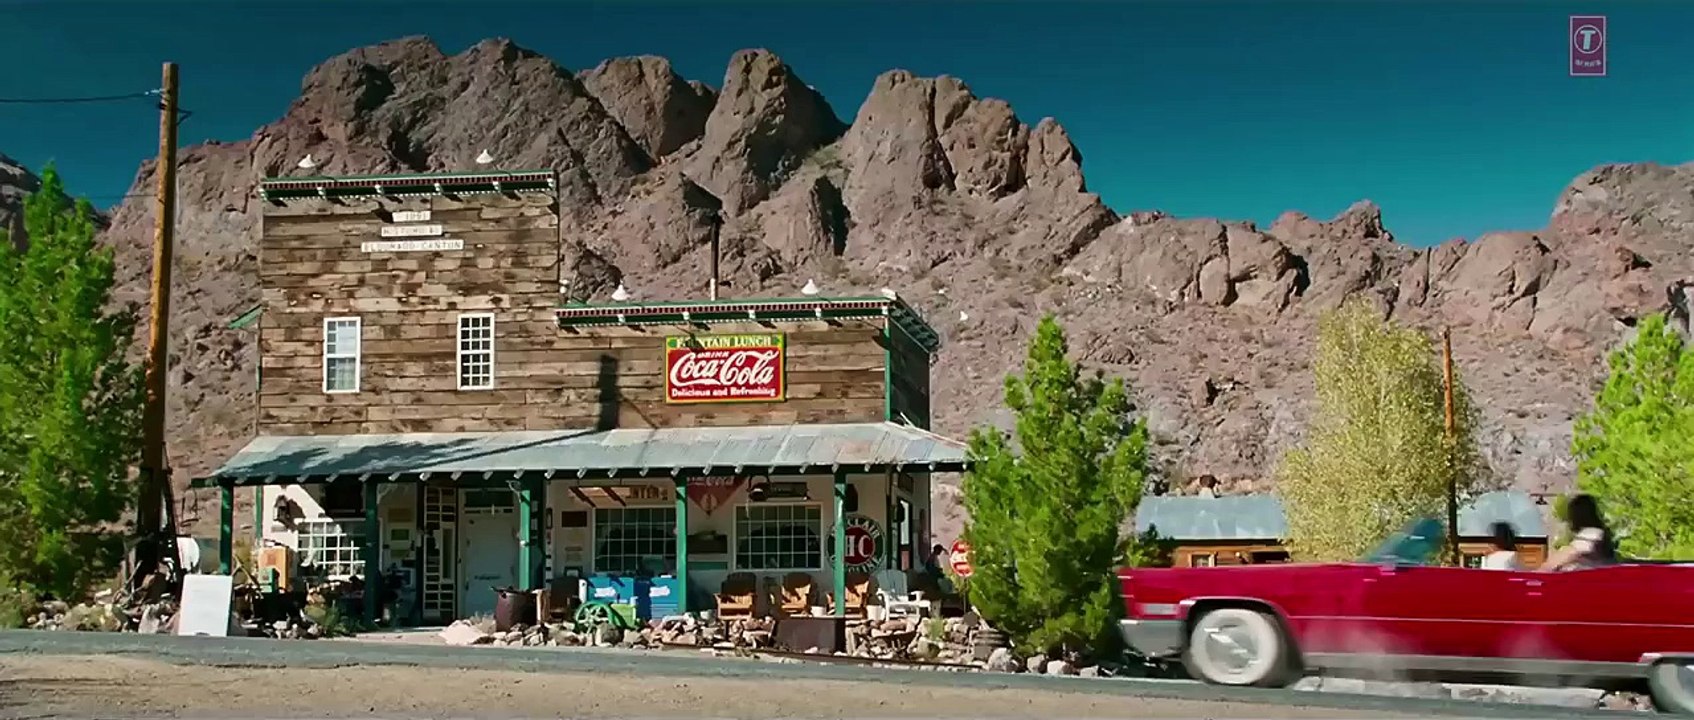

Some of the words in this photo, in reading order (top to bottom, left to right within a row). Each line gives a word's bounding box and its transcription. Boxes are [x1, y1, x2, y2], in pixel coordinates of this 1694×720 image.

[677, 338, 731, 348] FNTAIN
[734, 336, 771, 346] LUNCH
[669, 350, 779, 387] Coca-Cola
[671, 388, 710, 396] Delicious
[712, 387, 728, 396] and
[730, 386, 776, 396] Refreshing
